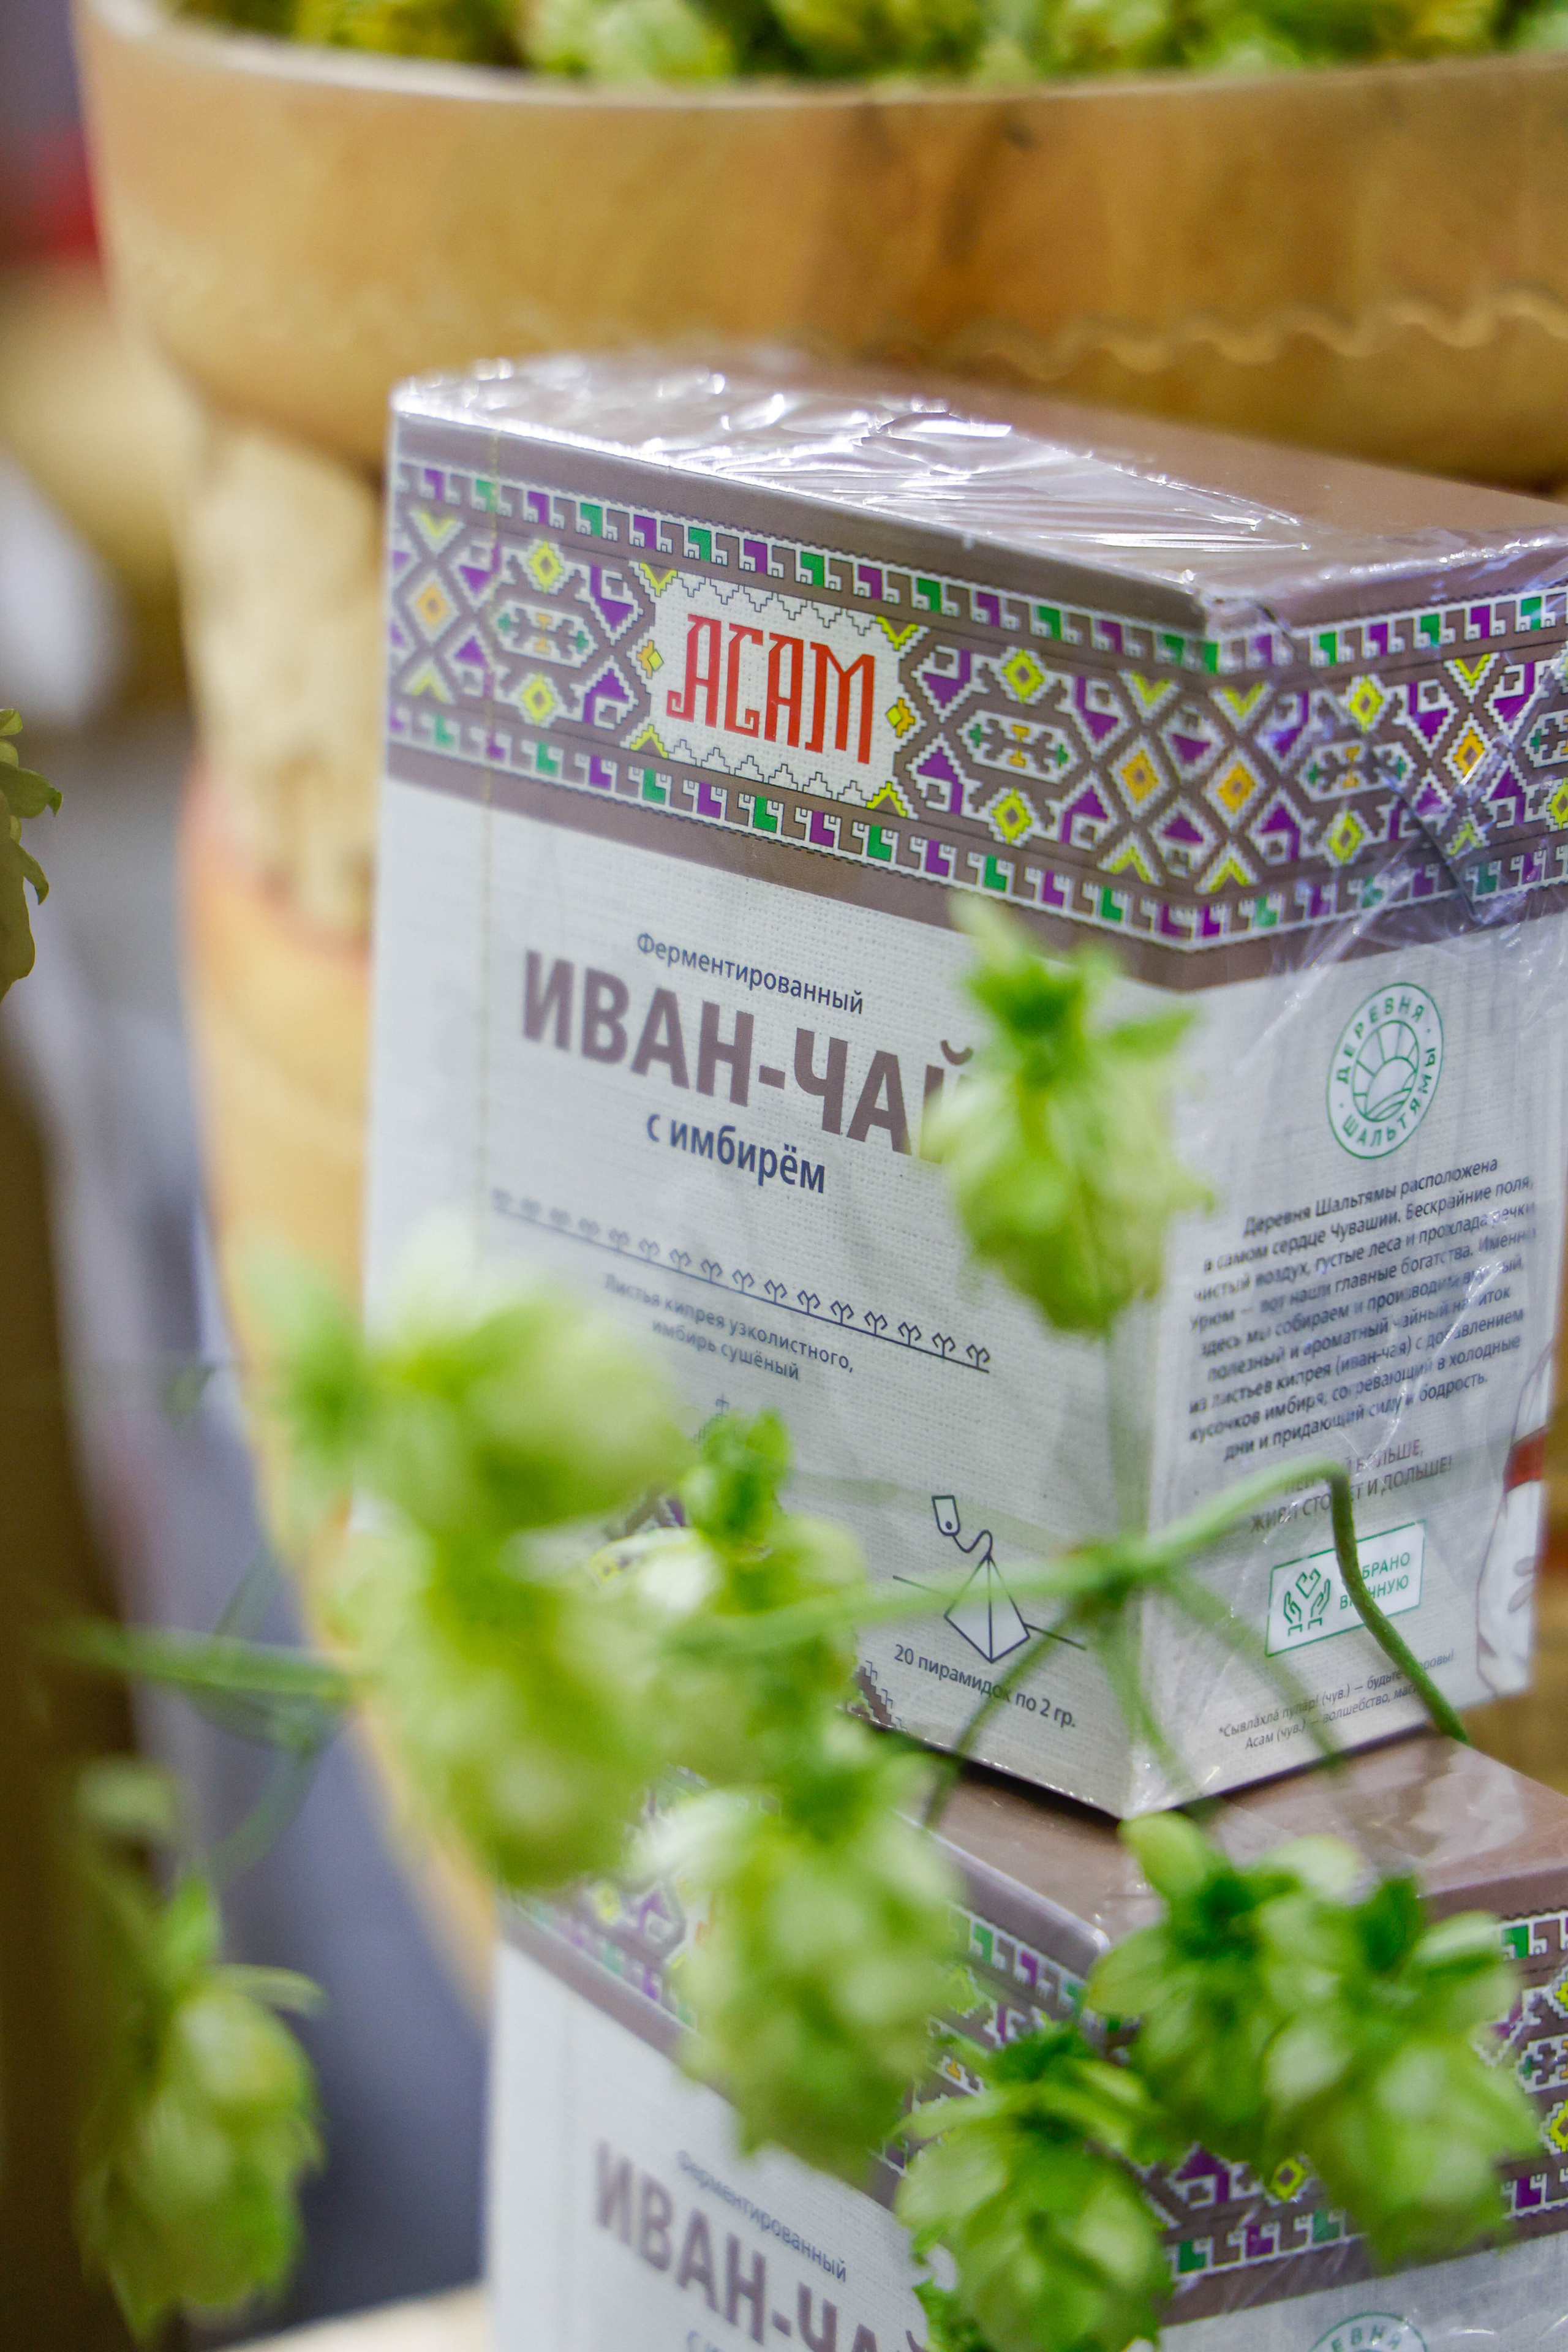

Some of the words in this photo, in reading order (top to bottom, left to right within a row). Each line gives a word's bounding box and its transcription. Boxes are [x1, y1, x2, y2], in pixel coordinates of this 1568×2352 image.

[666, 613, 875, 765] АСАМ
[637, 932, 864, 1015] Ферментированный
[522, 949, 974, 1165] ИВАН-ЧАЙ
[1336, 995, 1425, 1085] ДЕРЕВНЯ
[1342, 1047, 1436, 1148] ШАЛЬТЯМЫ
[646, 1112, 662, 1142] с
[669, 1120, 826, 1194] имбирём
[1216, 1245, 1269, 1270] самом
[1272, 1229, 1327, 1256] сердце
[1330, 1211, 1401, 1243] Чувашии.
[1406, 1186, 1492, 1221] Бескрайние
[1243, 1206, 1311, 1240] Деревня
[1315, 1185, 1397, 1217] Шальтямы
[1400, 1158, 1498, 1200] расположена
[1189, 1308, 1235, 1334] Урюм
[1335, 1264, 1397, 1294] главные
[1400, 1245, 1474, 1275] богатства.
[1315, 1247, 1365, 1275] густые
[1368, 1237, 1402, 1258] леса
[1406, 1233, 1415, 1246] и
[605, 1273, 660, 1307] Листья
[665, 1297, 725, 1329] кипрея
[729, 1317, 854, 1373] узколистного,
[652, 1319, 717, 1354] имбирь
[720, 1341, 799, 1381] сушёный
[1207, 1345, 1286, 1382] полезный
[1289, 1346, 1300, 1359] и
[1303, 1316, 1389, 1359] ароматный
[1453, 1286, 1511, 1314] наиток
[1275, 1305, 1349, 1336] собираем
[1189, 1397, 1208, 1415] из
[1276, 1363, 1332, 1390] кипрея
[1189, 1411, 1261, 1445] кусочков
[1265, 1391, 1329, 1422] имбиря,
[1437, 1357, 1446, 1371] в
[1449, 1334, 1521, 1367] холодные
[1223, 1439, 1255, 1462] дни
[1259, 1435, 1269, 1450] и
[1272, 1403, 1364, 1448] придающий
[1367, 1477, 1379, 1497] И
[1340, 1574, 1409, 1610] ВЧНУЮ
[1361, 1551, 1411, 1580] БРАНО
[893, 1643, 914, 1665] 20
[918, 1655, 1011, 1702] пирамидок
[1015, 1691, 1037, 1712] по
[1039, 1698, 1052, 1717] 2
[1054, 1706, 1076, 1728] гр.
[1245, 1732, 1274, 1751] Асам
[1322, 1692, 1391, 1724] волшебство,
[1322, 1683, 1351, 1706] (чув.)
